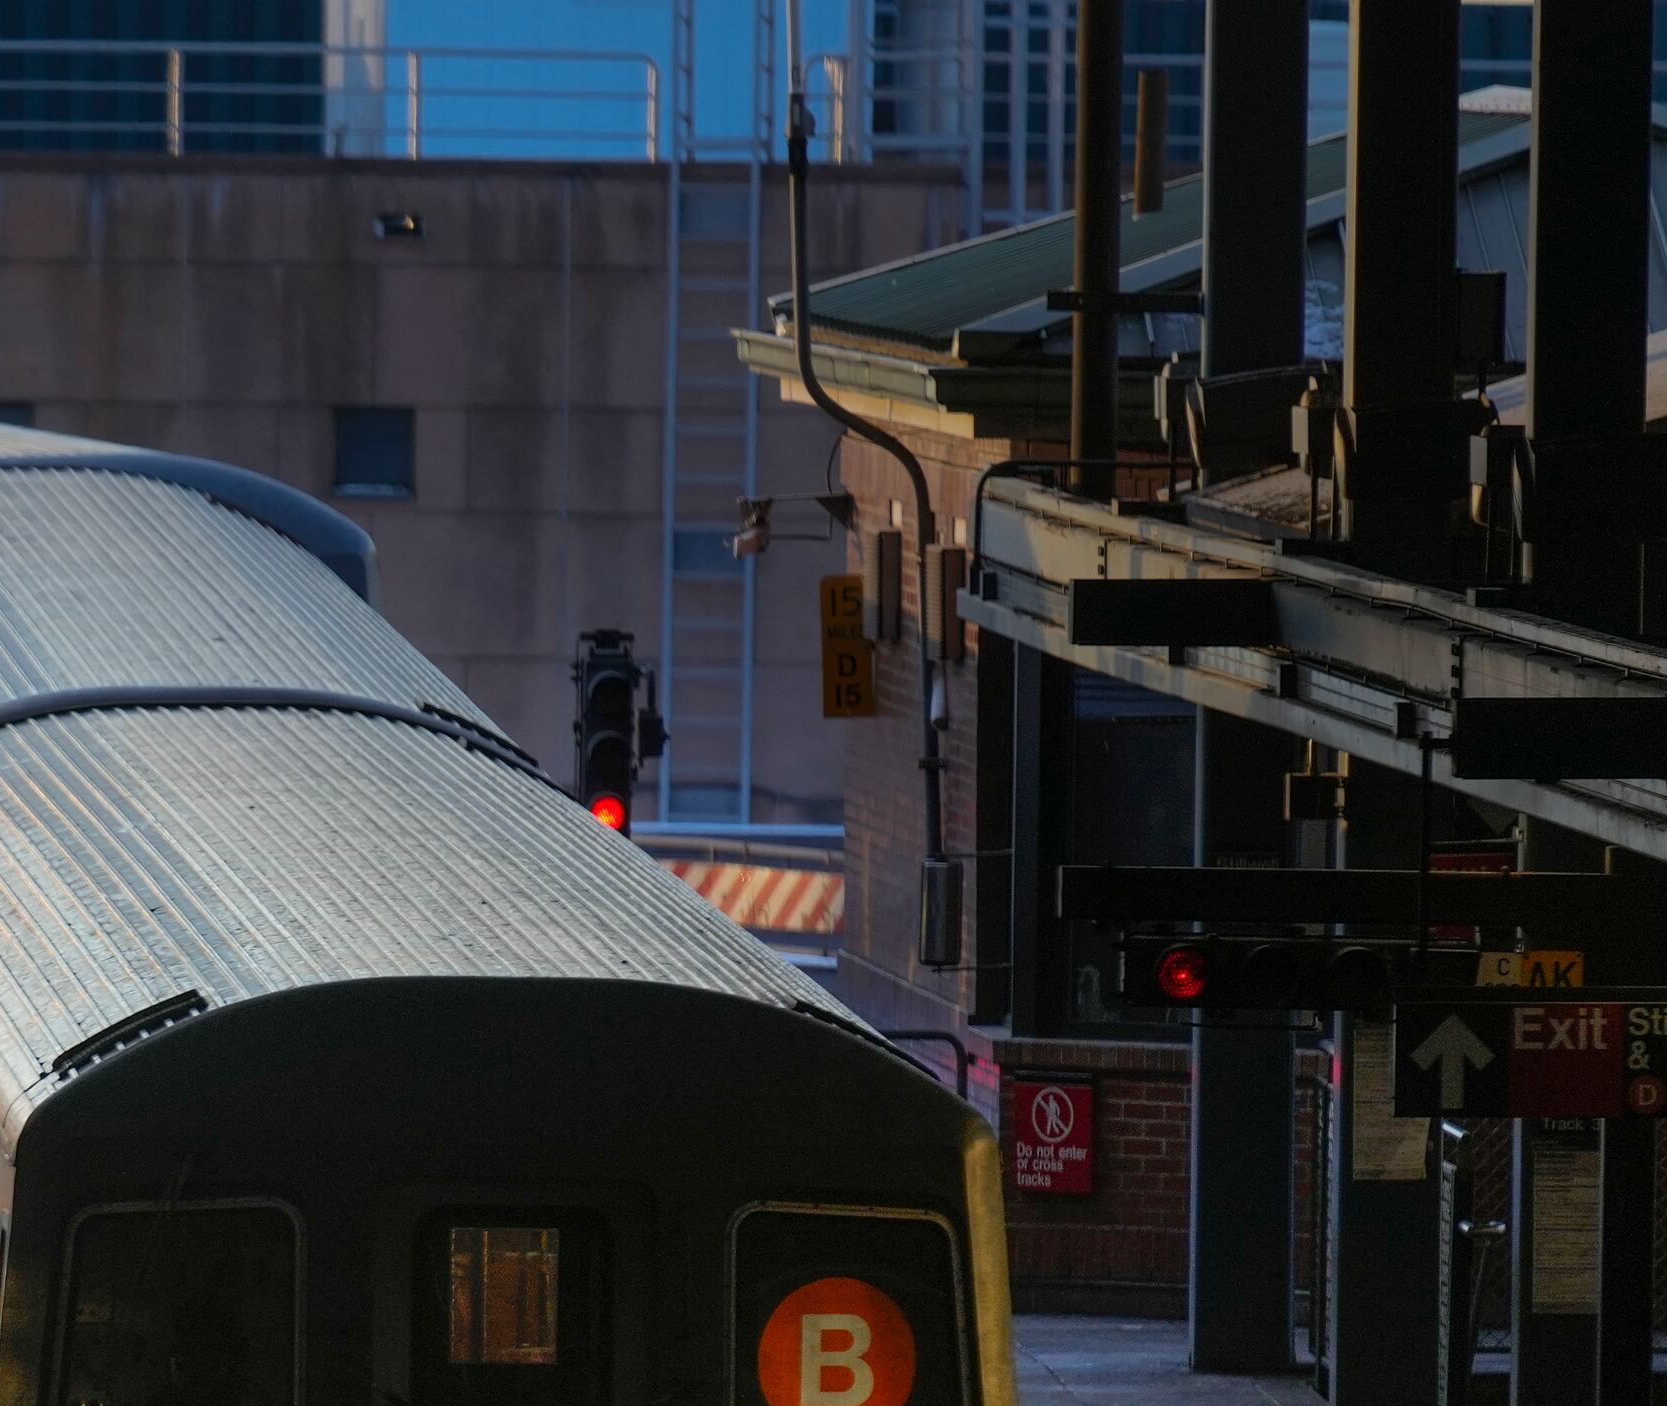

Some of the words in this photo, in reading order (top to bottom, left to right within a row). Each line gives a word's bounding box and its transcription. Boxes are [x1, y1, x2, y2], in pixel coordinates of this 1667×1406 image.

[831, 586, 861, 616] 15
[827, 625, 864, 638] MILE
[839, 654, 857, 677] D
[836, 684, 861, 707] 15
[1498, 958, 1510, 975] C
[1514, 1007, 1607, 1049] Exit
[1628, 1041, 1649, 1069] &
[1639, 1084, 1657, 1105] D
[1016, 1142, 1032, 1158] Do
[1036, 1144, 1055, 1159] not
